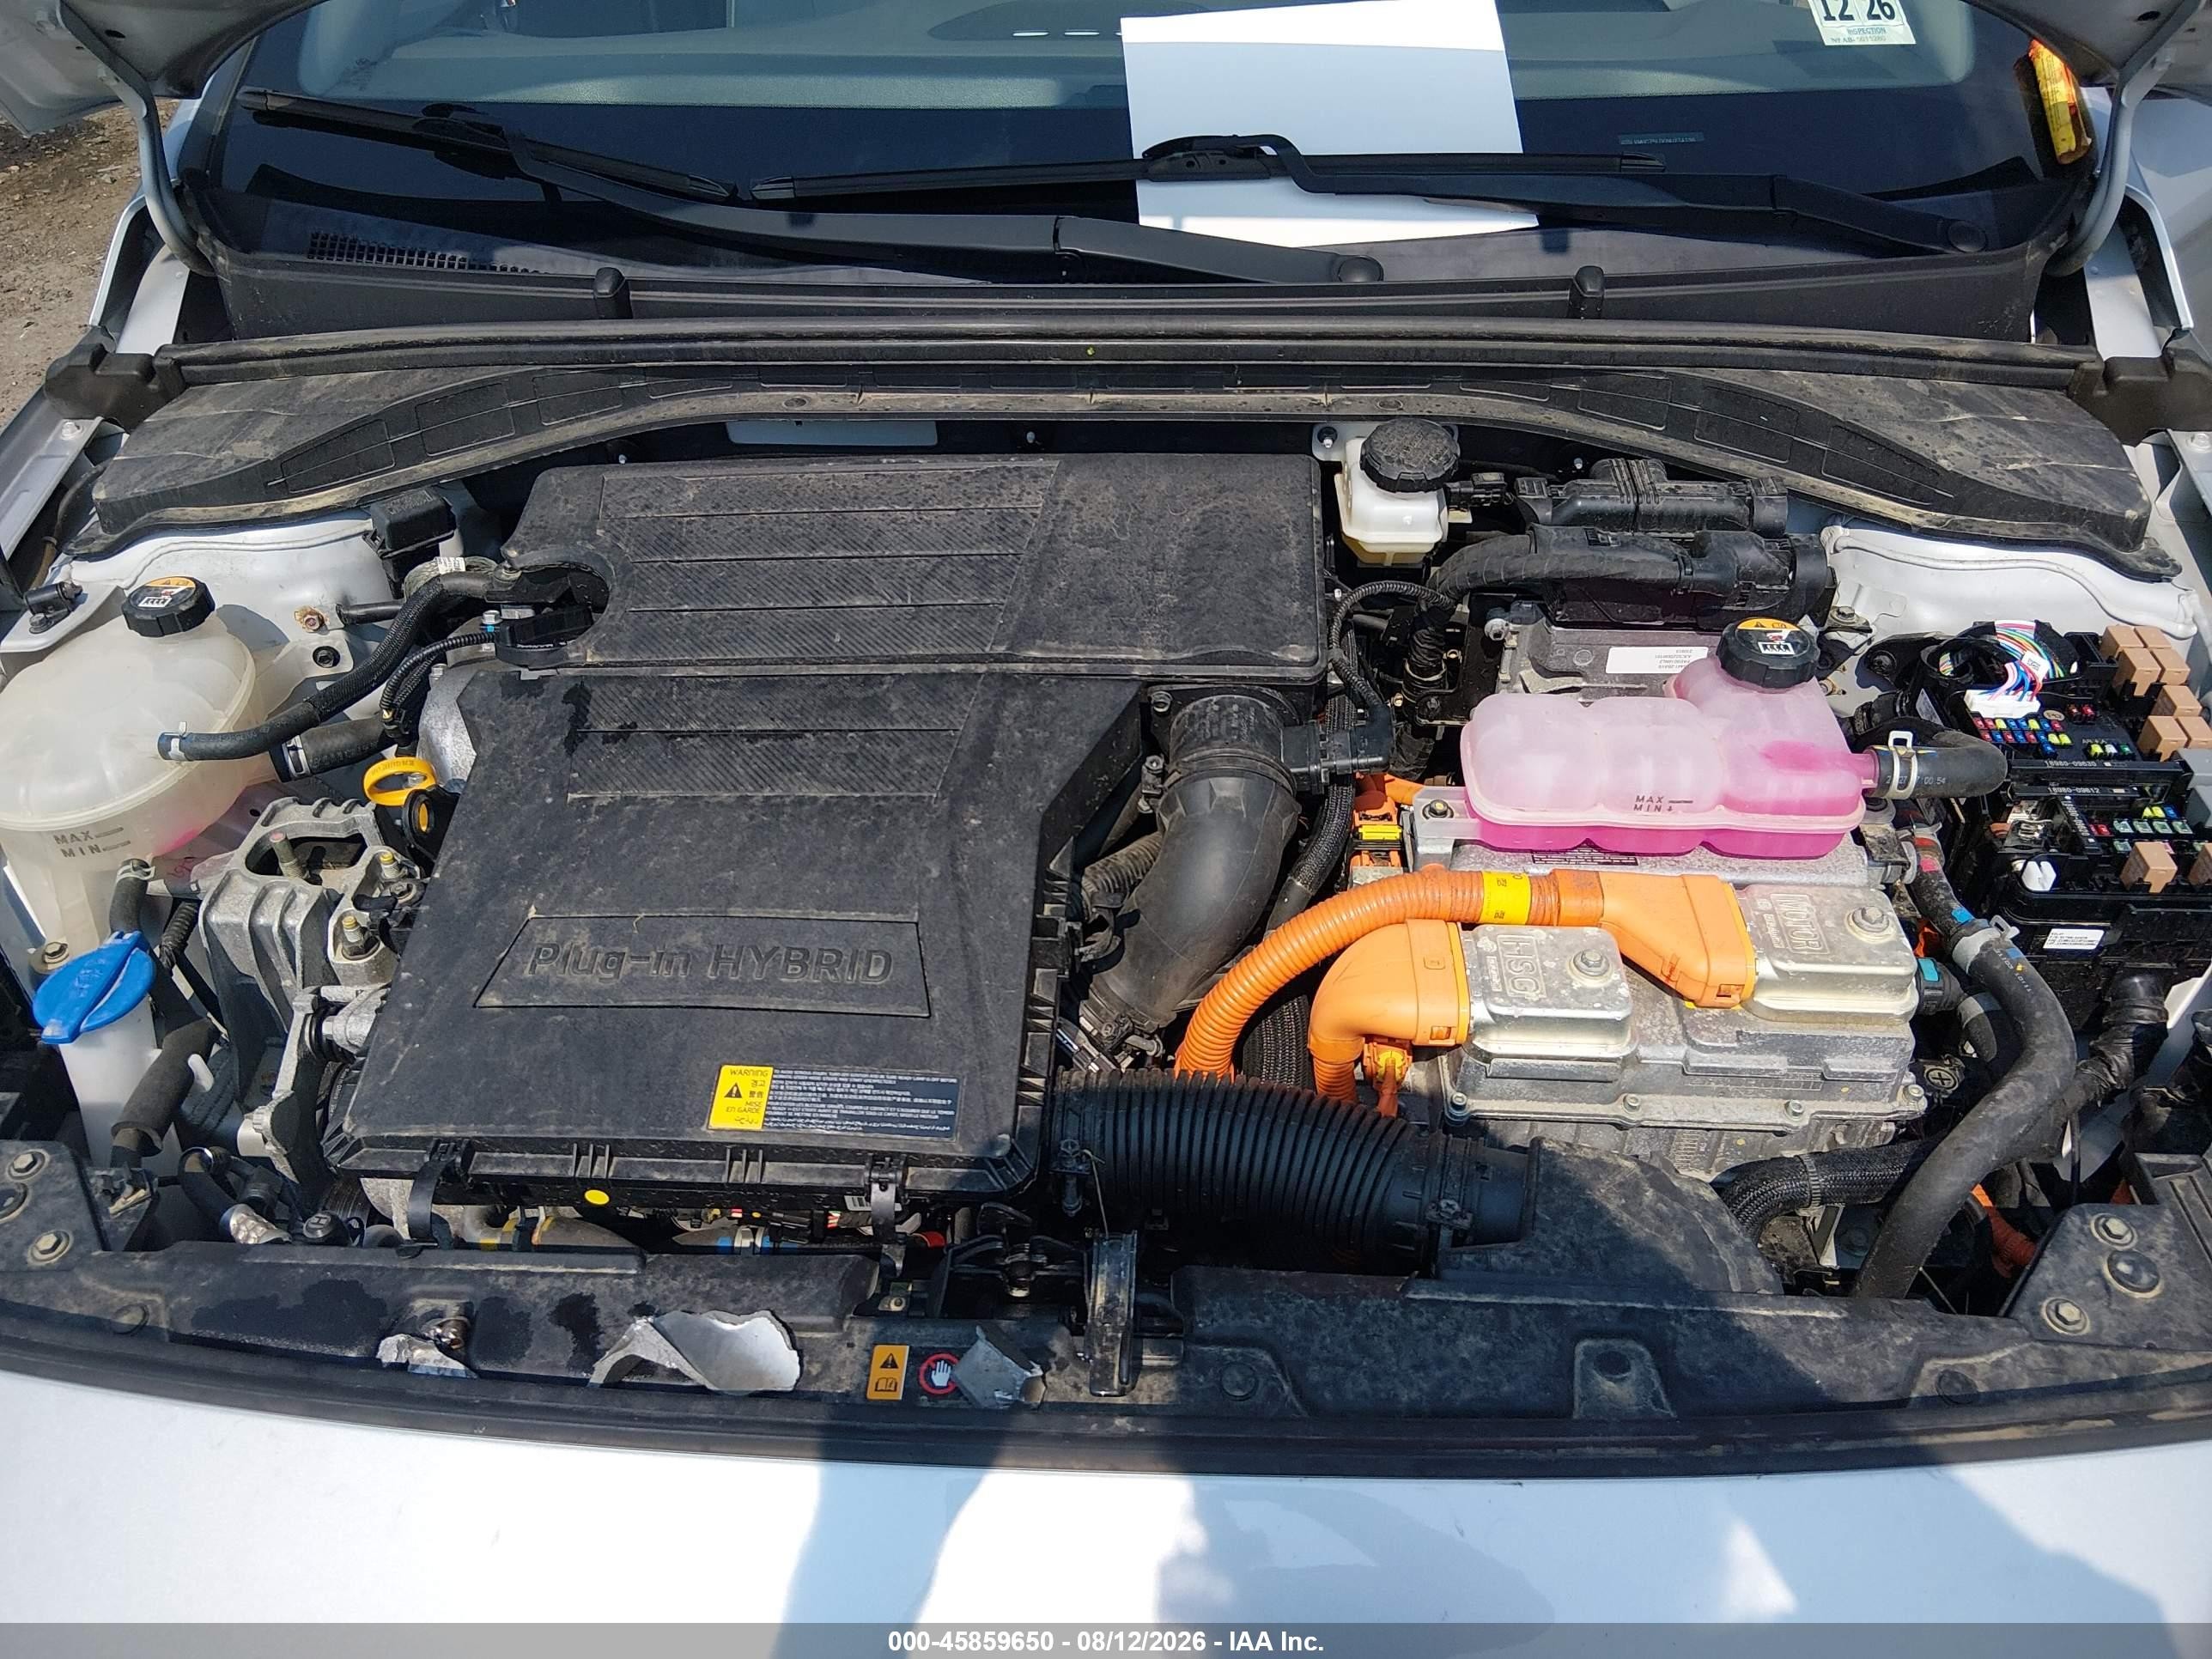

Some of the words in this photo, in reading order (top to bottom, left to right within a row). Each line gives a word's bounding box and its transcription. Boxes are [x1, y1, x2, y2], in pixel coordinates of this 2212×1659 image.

[53, 830, 94, 845] MAX
[60, 844, 101, 859] MIN
[1776, 899, 1824, 950] MOTOR
[526, 942, 690, 982] Plug-in
[708, 945, 893, 984] HYBRID
[1503, 940, 1540, 993] HSG
